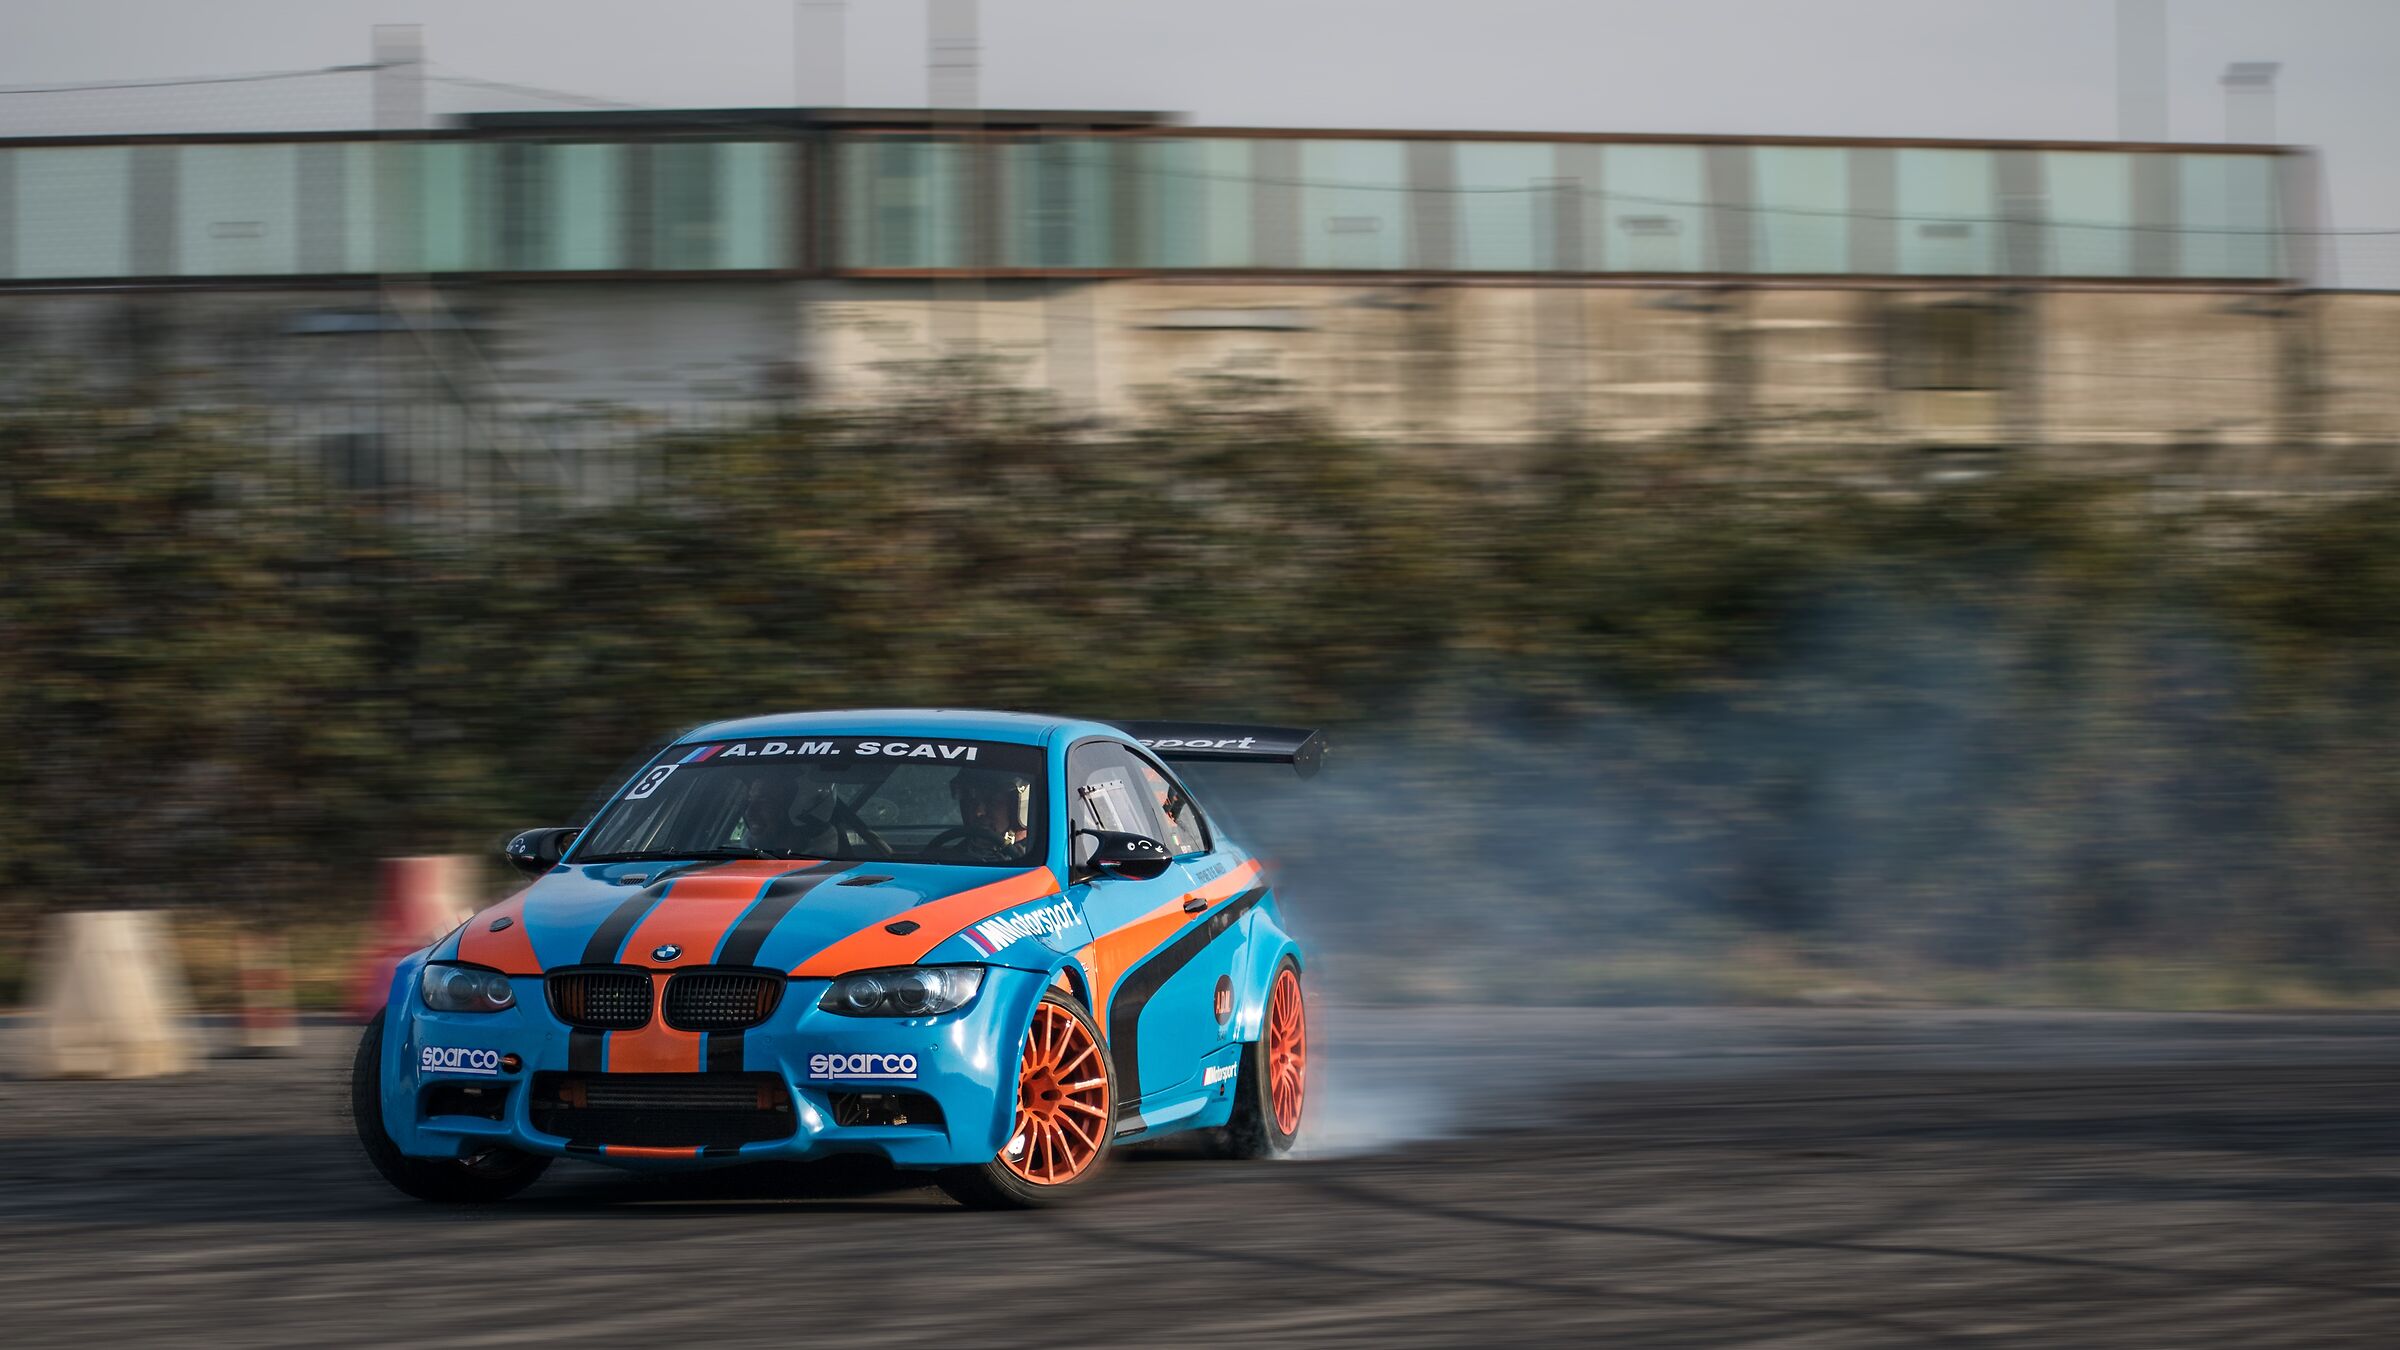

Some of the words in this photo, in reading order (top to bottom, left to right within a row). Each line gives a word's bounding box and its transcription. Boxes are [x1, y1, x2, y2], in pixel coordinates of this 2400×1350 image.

[719, 741, 841, 758] A.D.M.
[855, 741, 978, 761] SCAVI
[633, 766, 671, 795] 8
[421, 1046, 499, 1073] sparco
[809, 1053, 918, 1080] sparco
